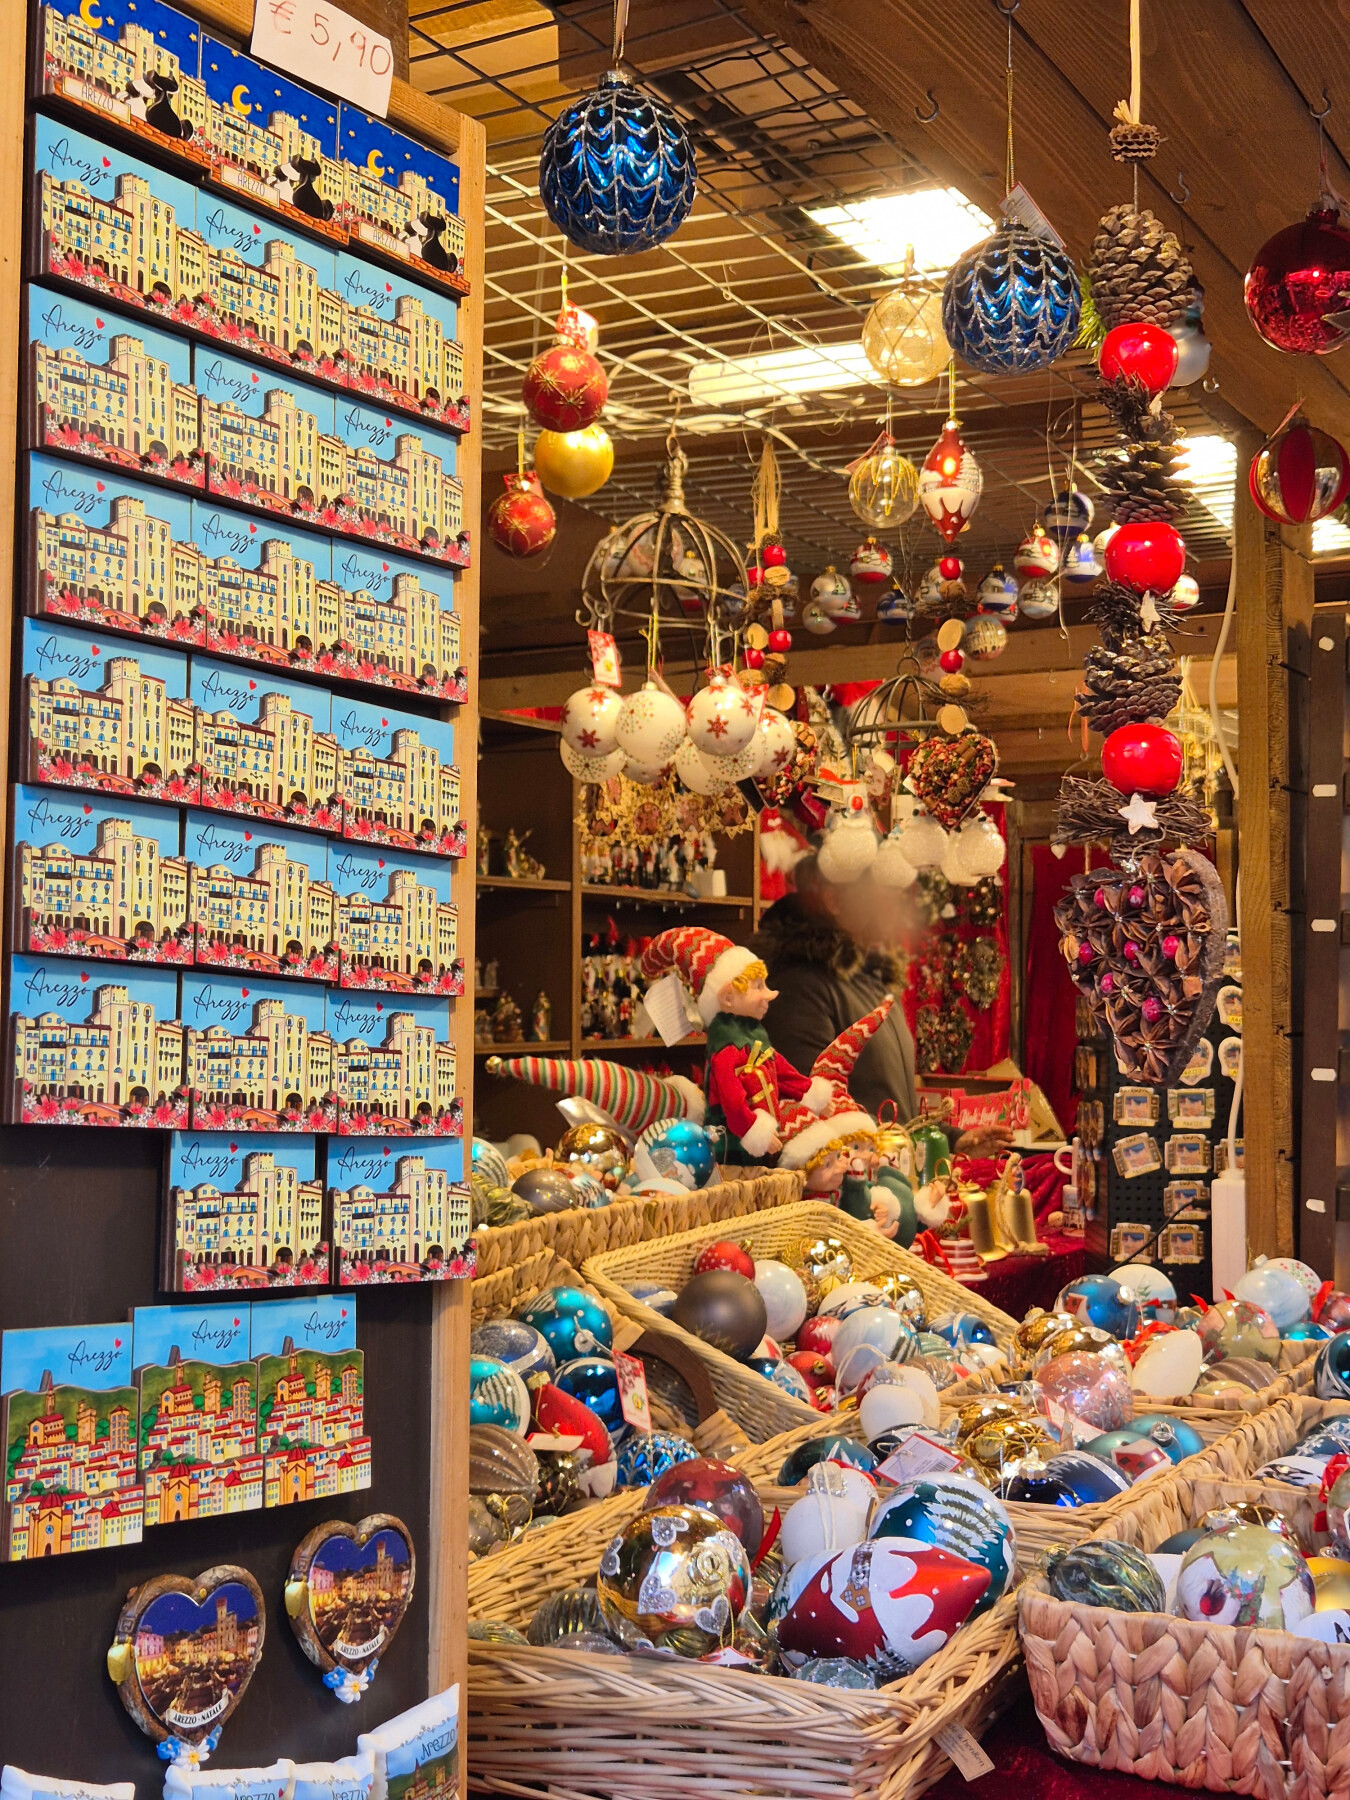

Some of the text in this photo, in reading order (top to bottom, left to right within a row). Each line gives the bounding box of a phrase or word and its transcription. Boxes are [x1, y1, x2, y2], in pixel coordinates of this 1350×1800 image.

[268, 0, 391, 75] € 5,90
[81, 84, 114, 111] AREZZO
[48, 138, 112, 186] Arezzo
[237, 173, 266, 197] AREZZO
[206, 209, 261, 252] Arezzo
[373, 229, 397, 250] AREZZO
[344, 269, 392, 309] Arezzo
[42, 304, 106, 349] Arezzo
[204, 361, 260, 402] Arezzo
[344, 407, 392, 445] Arezzo
[42, 471, 106, 513] Arezzo
[202, 514, 258, 553] Arezzo
[342, 554, 390, 589] Arezzo
[36, 636, 101, 677] Arezzo
[201, 671, 258, 709] Arezzo
[340, 711, 389, 748] Arezzo
[28, 799, 93, 838] Arezzo
[196, 824, 253, 862] Arezzo
[337, 853, 386, 887] Arezzo
[24, 967, 91, 1006] Arezzo
[194, 984, 250, 1020] Arezzo
[335, 999, 384, 1034] Arezzo
[181, 1141, 239, 1176] Arezzo
[337, 1146, 392, 1179] Arezzo
[192, 1319, 241, 1348] Arezzo
[304, 1310, 348, 1339] Arezzo
[68, 1340, 124, 1372] Arezzo
[340, 1643, 360, 1656] AREZZO
[172, 1712, 197, 1724] AREZZO
[201, 1704, 222, 1720] NATALE
[420, 1728, 456, 1761] Arezzo
